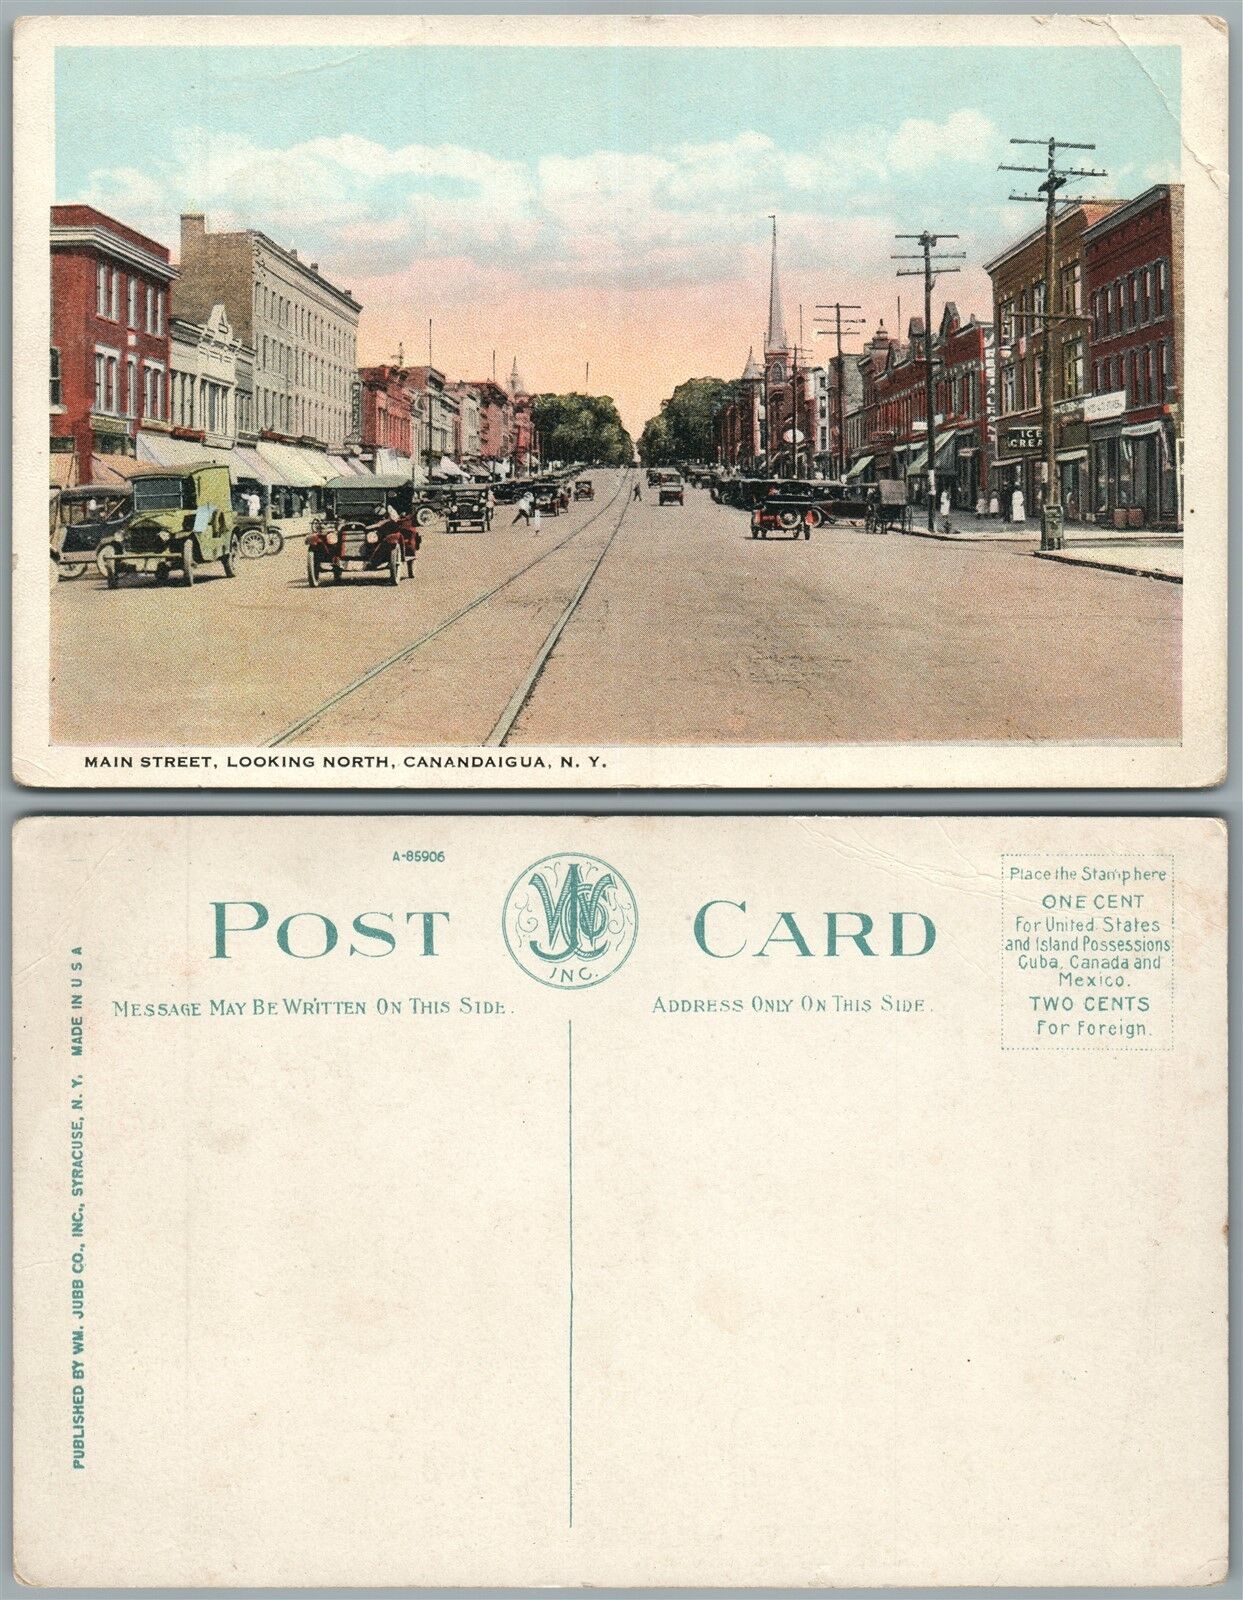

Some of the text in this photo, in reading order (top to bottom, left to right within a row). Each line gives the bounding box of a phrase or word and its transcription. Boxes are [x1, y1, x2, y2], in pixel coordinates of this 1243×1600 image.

[1020, 429, 1042, 439] ICE
[1010, 438, 1043, 448] CREA
[85, 756, 607, 770] MAIN STREET, LOOKING NORTH, CANANDAIGUA, N. Y.
[393, 849, 446, 863] A-85906
[1007, 865, 1167, 887] Place the Stamp here
[1042, 894, 1144, 910] ONE CENT
[209, 901, 450, 960] POST
[694, 900, 937, 959] CARD
[1016, 916, 1161, 933] For United States
[1005, 936, 1171, 953] and Island Possessions
[1070, 955, 1130, 970] Canada
[1134, 955, 1161, 970] and
[549, 966, 599, 983] INC.
[1059, 972, 1131, 987] Mexico.
[71, 993, 83, 1010] IN
[1029, 996, 1150, 1012] TWO CENTS
[71, 1016, 83, 1057] MADE
[1037, 1018, 1153, 1040] For Foreign.
[71, 1075, 86, 1470] PUBLISHED BY WM. JUBB CO., INC., SYRACUSE, N. Y.
